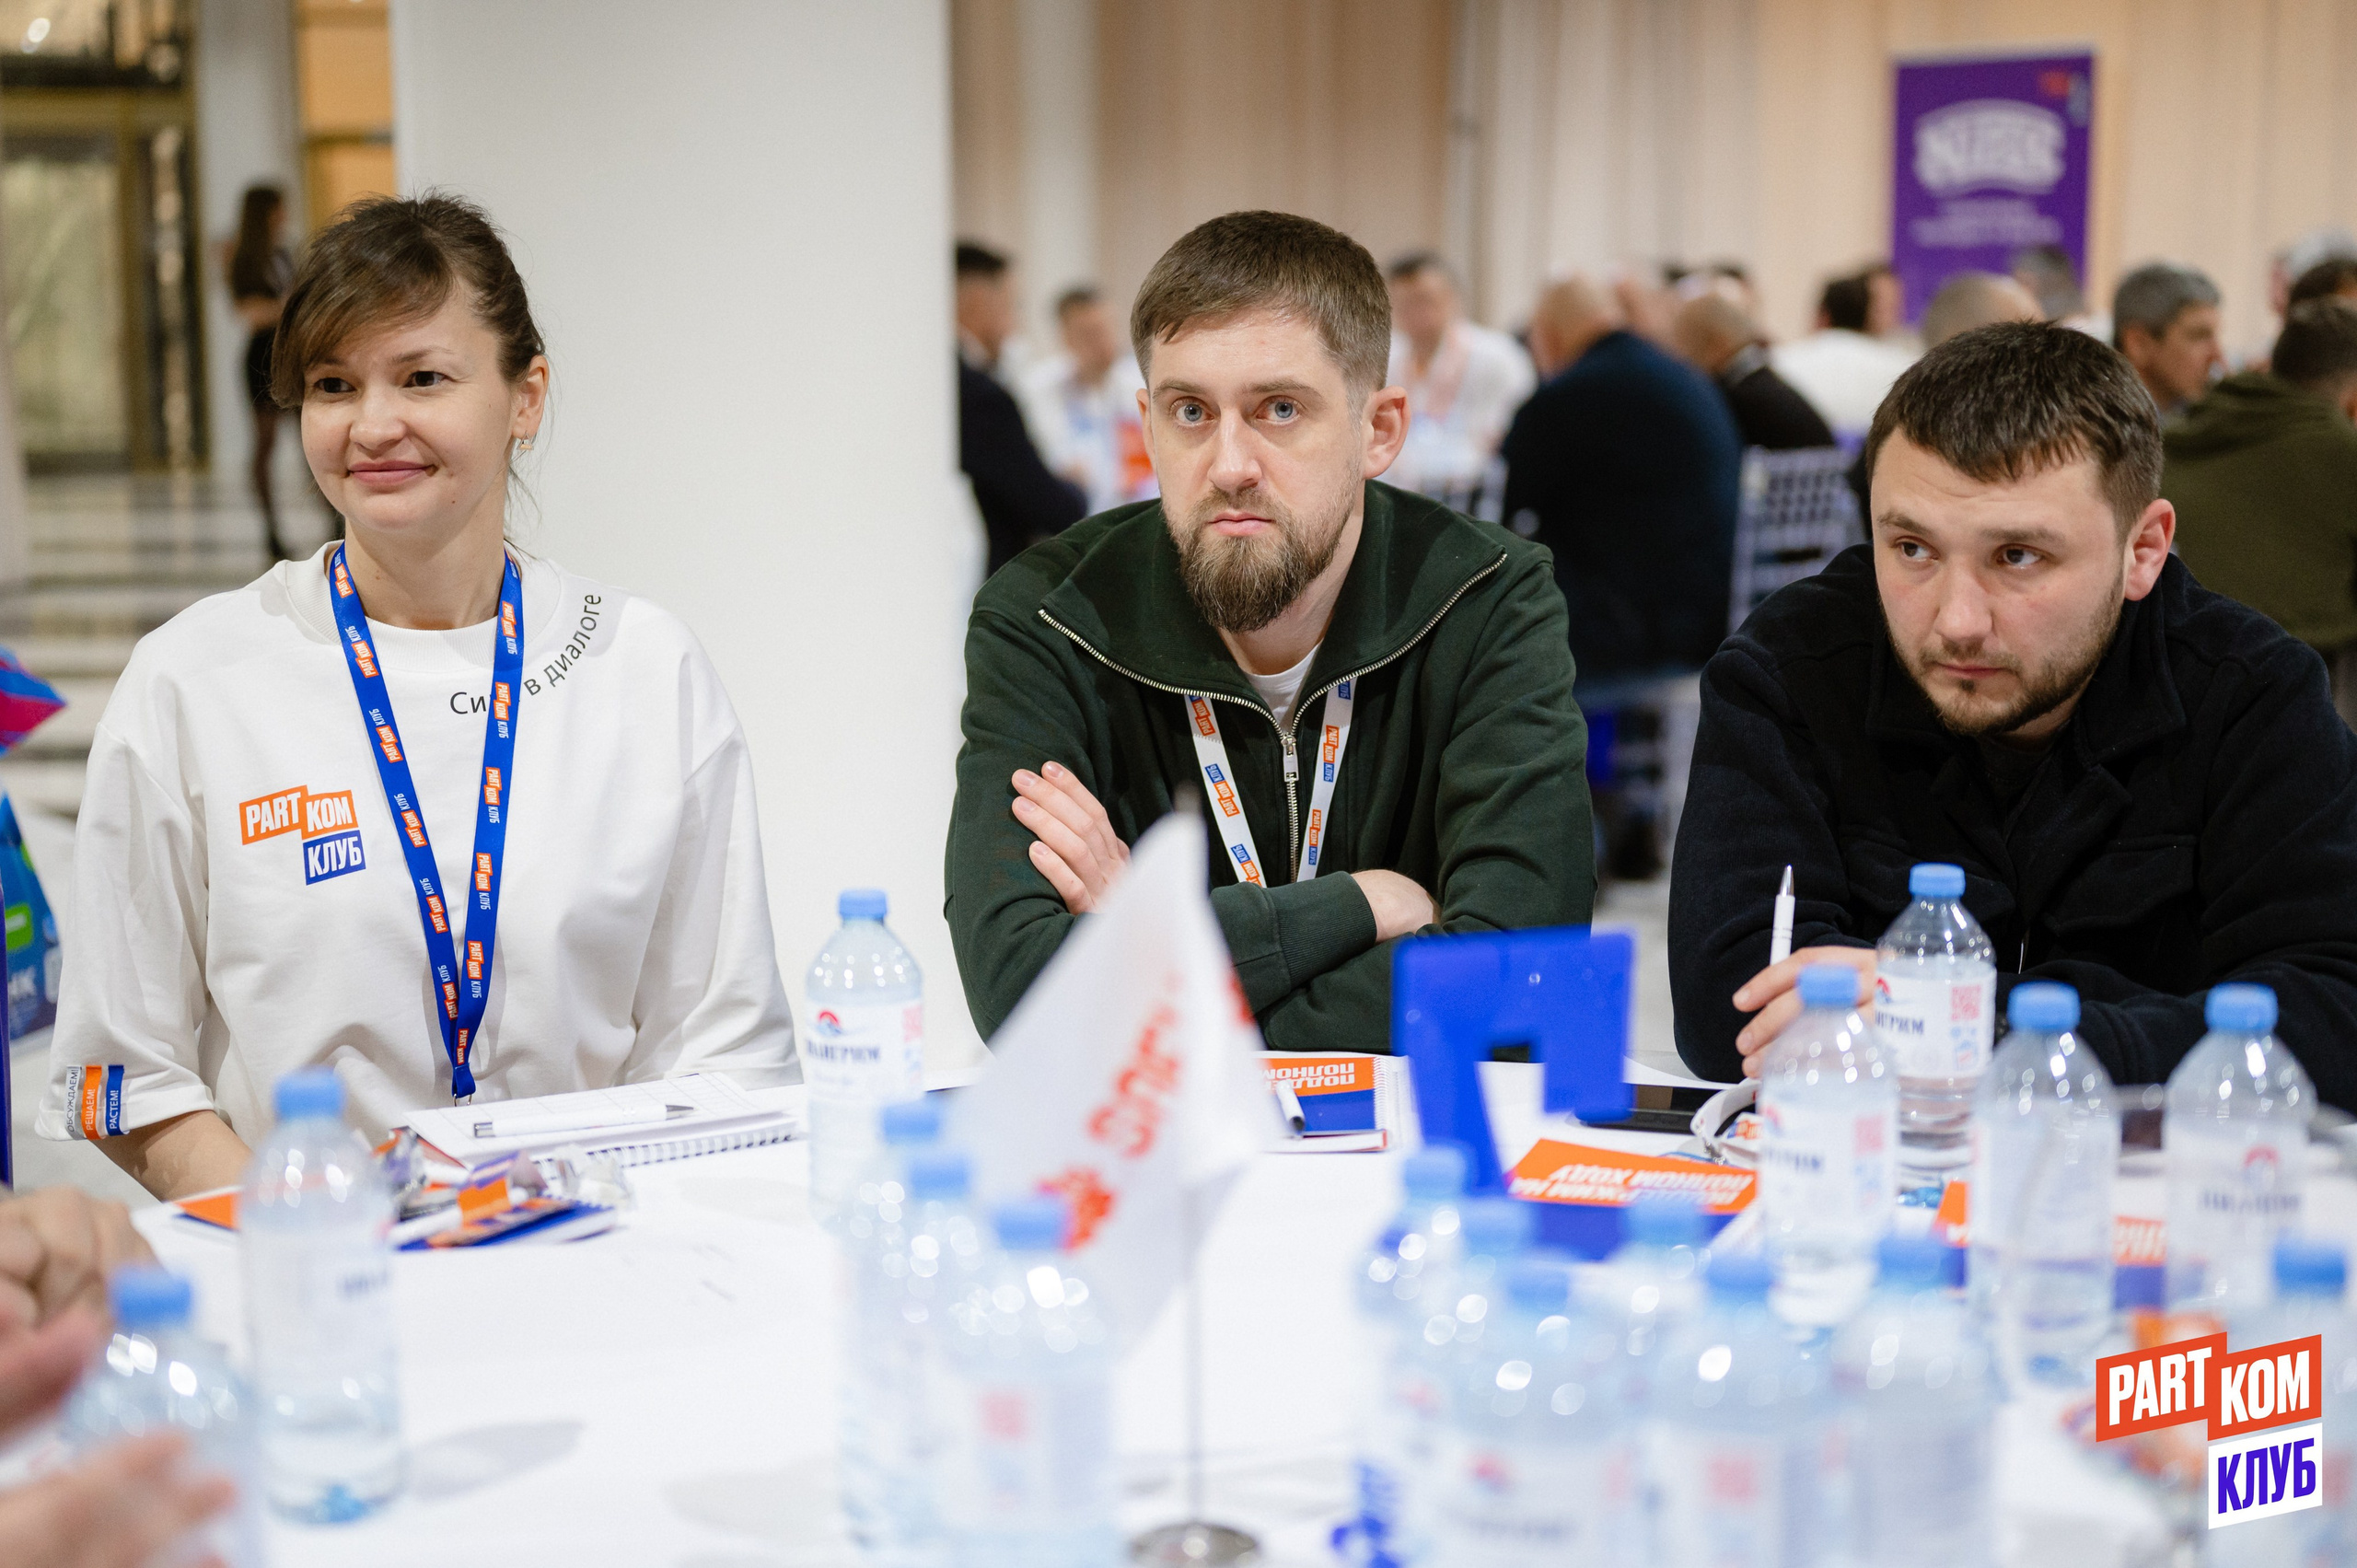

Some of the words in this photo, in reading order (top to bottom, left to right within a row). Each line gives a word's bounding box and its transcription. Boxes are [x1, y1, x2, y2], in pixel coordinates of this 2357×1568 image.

[523, 678, 541, 695] в
[543, 594, 601, 687] диалоге
[246, 792, 301, 837] PART
[306, 796, 353, 832] KOM
[308, 836, 362, 877] КЛУБ
[66, 1069, 78, 1132] ОБСУЖДАЕМ!
[85, 1089, 95, 1131] РЕШАЕМ!
[109, 1090, 119, 1130] РАСТЕМ!
[1548, 1164, 1634, 1185] ХОДУ
